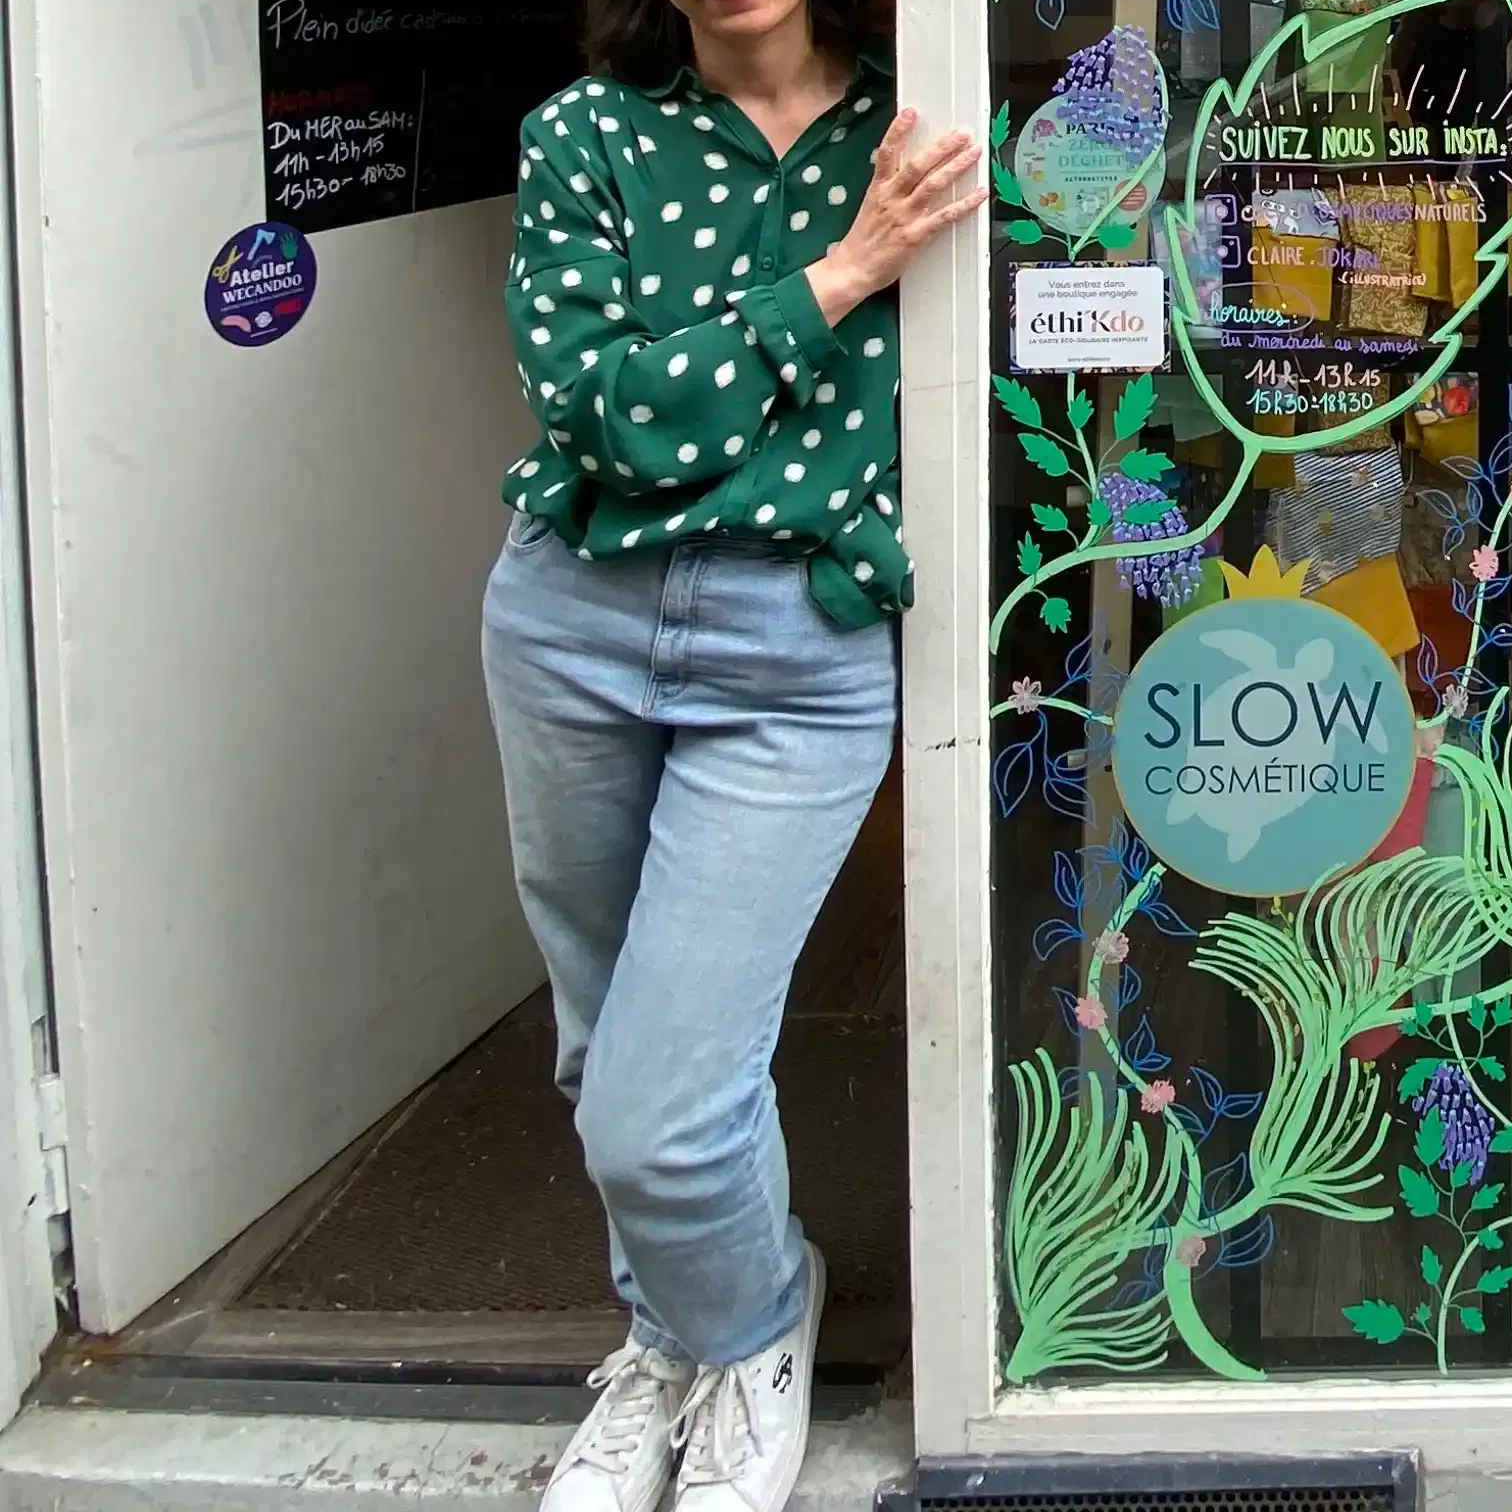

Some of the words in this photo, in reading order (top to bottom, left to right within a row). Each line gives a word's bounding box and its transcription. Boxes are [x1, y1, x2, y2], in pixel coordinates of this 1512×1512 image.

[267, 122, 301, 149] Du
[1219, 120, 1310, 162] SUIVEZ
[1320, 125, 1376, 159] NOUS
[1388, 125, 1430, 157] SUR
[229, 259, 295, 288] Atelier
[1047, 279, 1071, 289] Vous
[1072, 279, 1101, 289] entrez
[1103, 279, 1126, 289] dans
[222, 273, 303, 305] WECANDOO
[1037, 290, 1056, 299] une
[1056, 289, 1098, 300] boutique
[1098, 289, 1139, 300] engagée
[1248, 331, 1326, 350] mercredi
[1143, 680, 1383, 750] SLOW
[1144, 756, 1386, 796] COSMÉTIQUE
